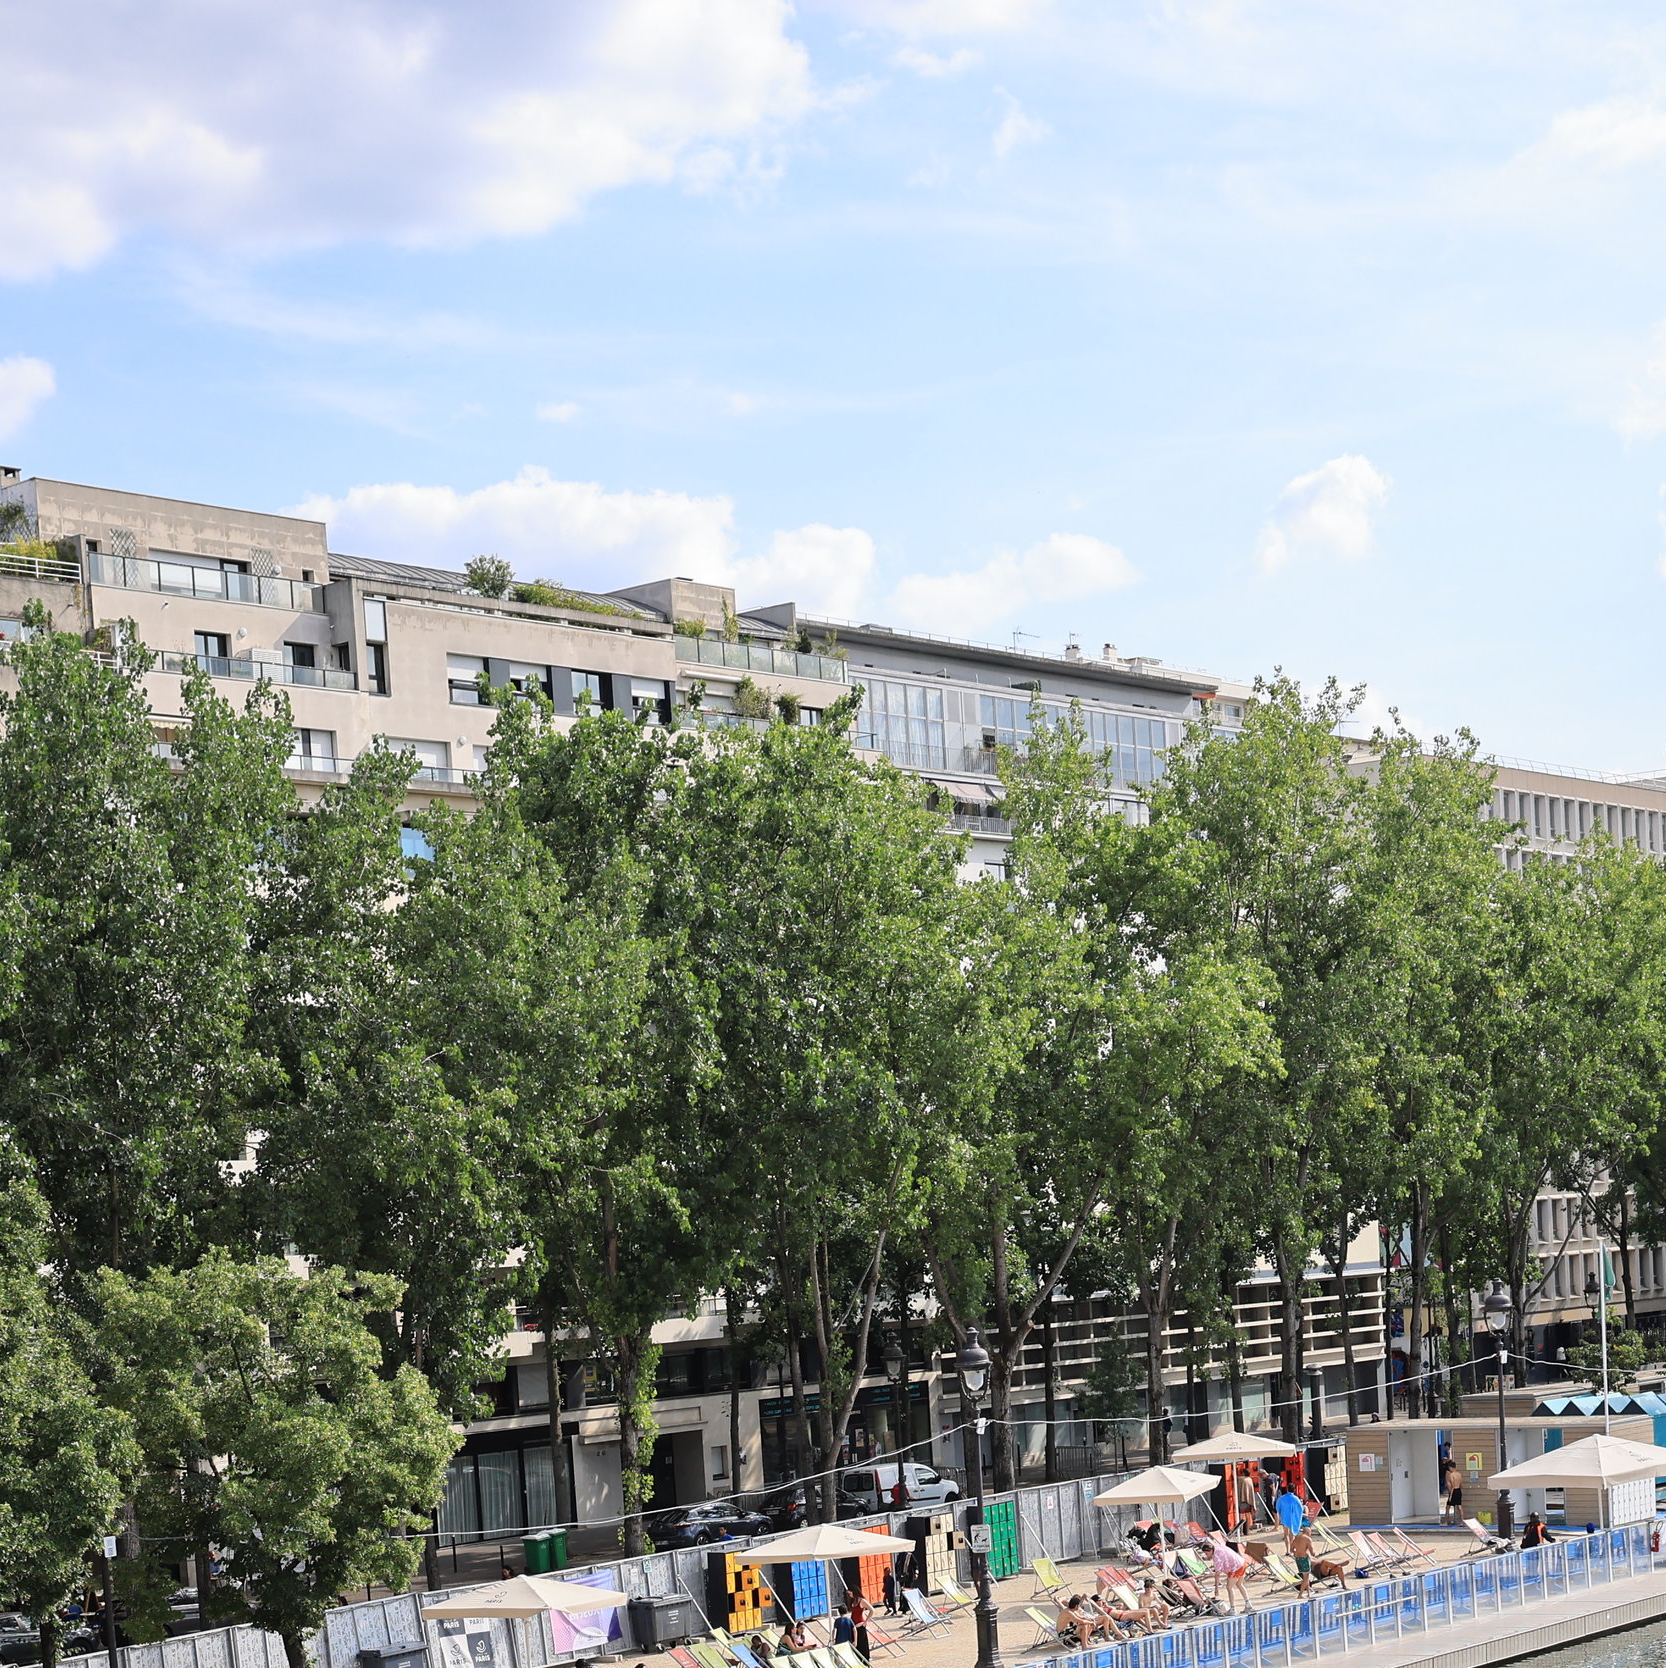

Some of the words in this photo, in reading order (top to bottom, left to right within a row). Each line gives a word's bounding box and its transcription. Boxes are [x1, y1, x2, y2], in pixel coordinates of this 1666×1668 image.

[443, 1621, 460, 1629] PARIS
[449, 1657, 467, 1666] PARIS
[475, 1654, 491, 1663] PARIS
